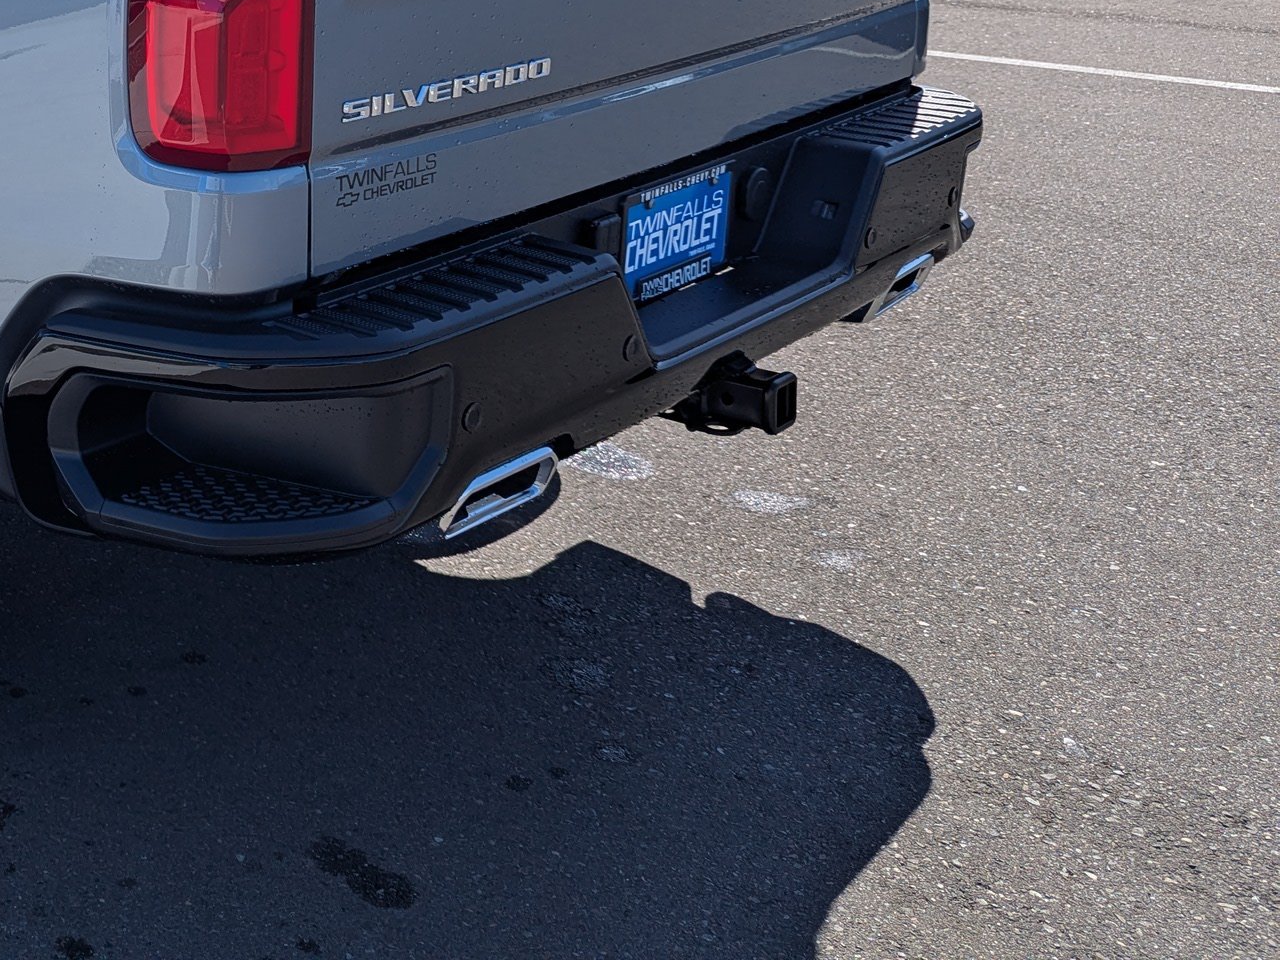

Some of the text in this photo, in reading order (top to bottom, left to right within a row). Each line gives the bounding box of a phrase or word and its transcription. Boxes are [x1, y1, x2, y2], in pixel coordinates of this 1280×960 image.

[341, 57, 552, 123] SILVERADO
[335, 152, 438, 192] TWINFALLS
[363, 171, 438, 201] CHEVROLET
[639, 164, 727, 203] TWINFALLS-CHEVY.COM
[629, 189, 724, 241] TWINFALLS
[624, 207, 723, 274] CHEVROLET
[662, 256, 712, 292] CHEVROLET
